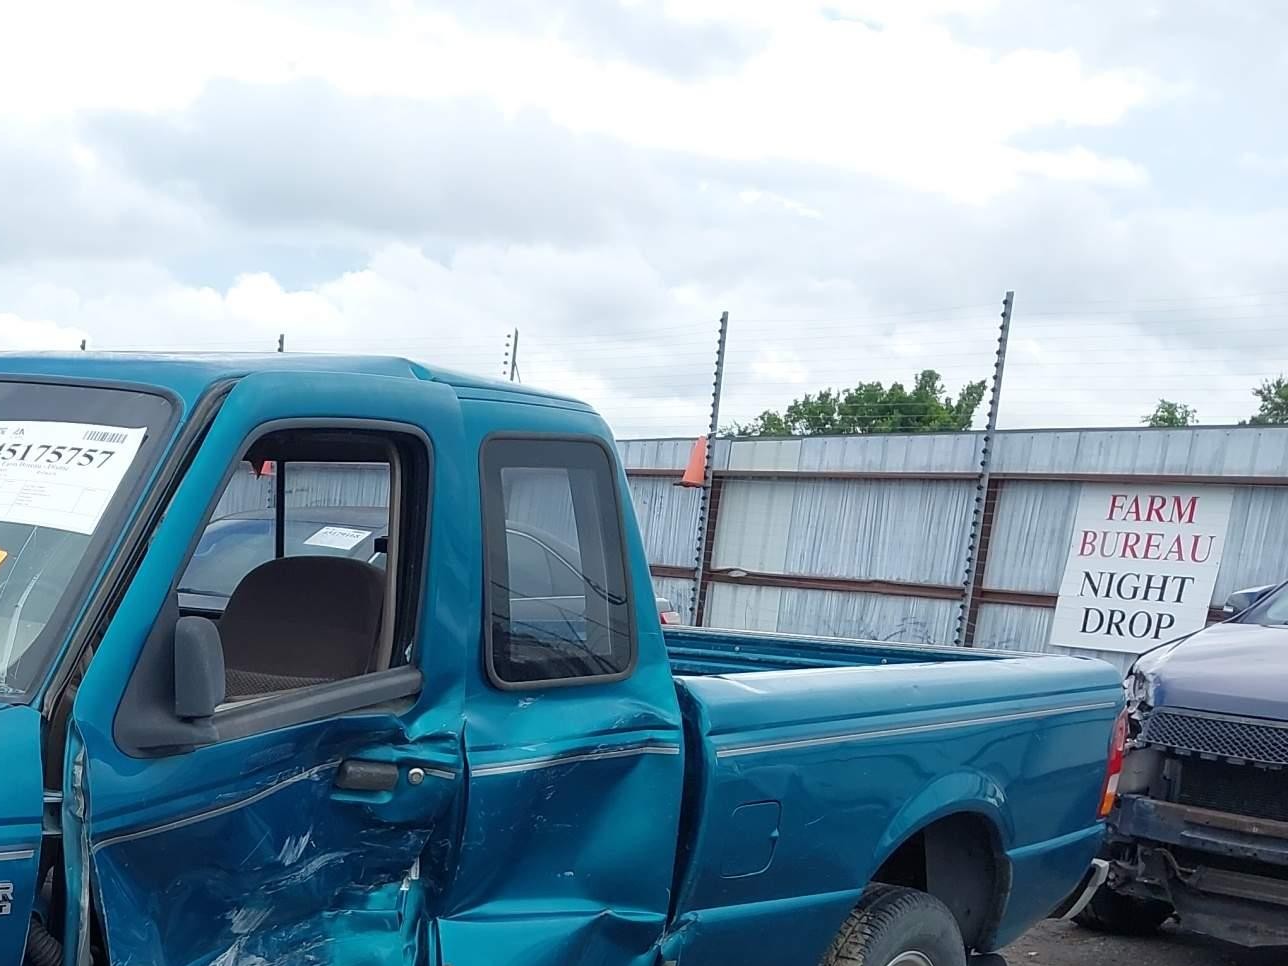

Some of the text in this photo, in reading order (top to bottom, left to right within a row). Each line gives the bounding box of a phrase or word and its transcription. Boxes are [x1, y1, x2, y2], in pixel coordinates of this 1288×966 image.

[1106, 494, 1200, 524] FARM
[1078, 530, 1216, 563] BUREAU
[1080, 570, 1195, 604] NIGHT
[1080, 606, 1175, 640] DROP
